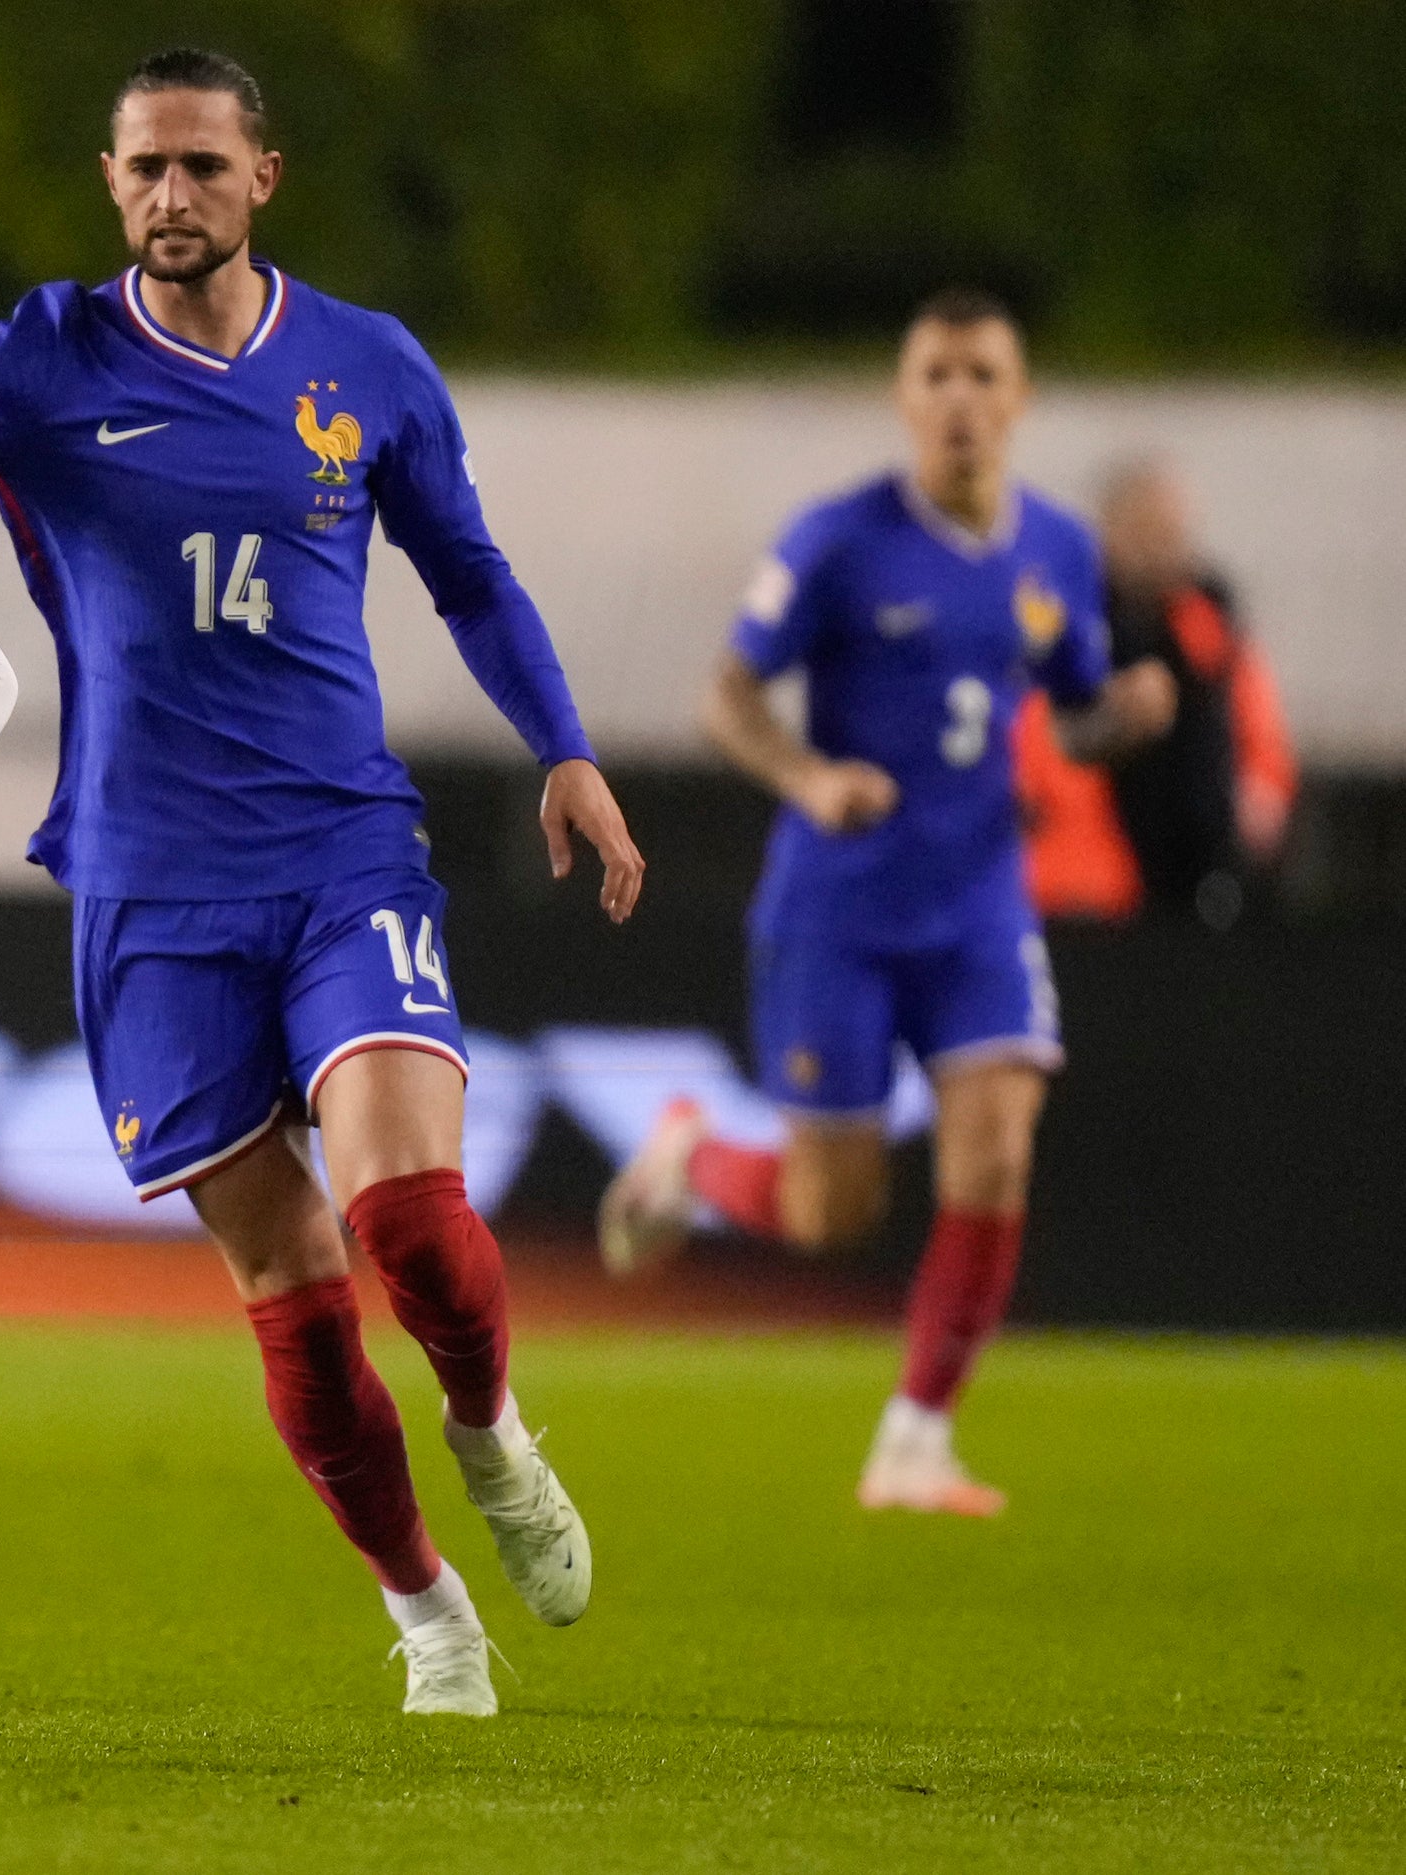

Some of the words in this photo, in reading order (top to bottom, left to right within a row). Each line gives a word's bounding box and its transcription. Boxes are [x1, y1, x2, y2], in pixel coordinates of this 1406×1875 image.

[181, 531, 274, 634] 14
[940, 674, 993, 769] 3
[369, 908, 449, 1002] 14
